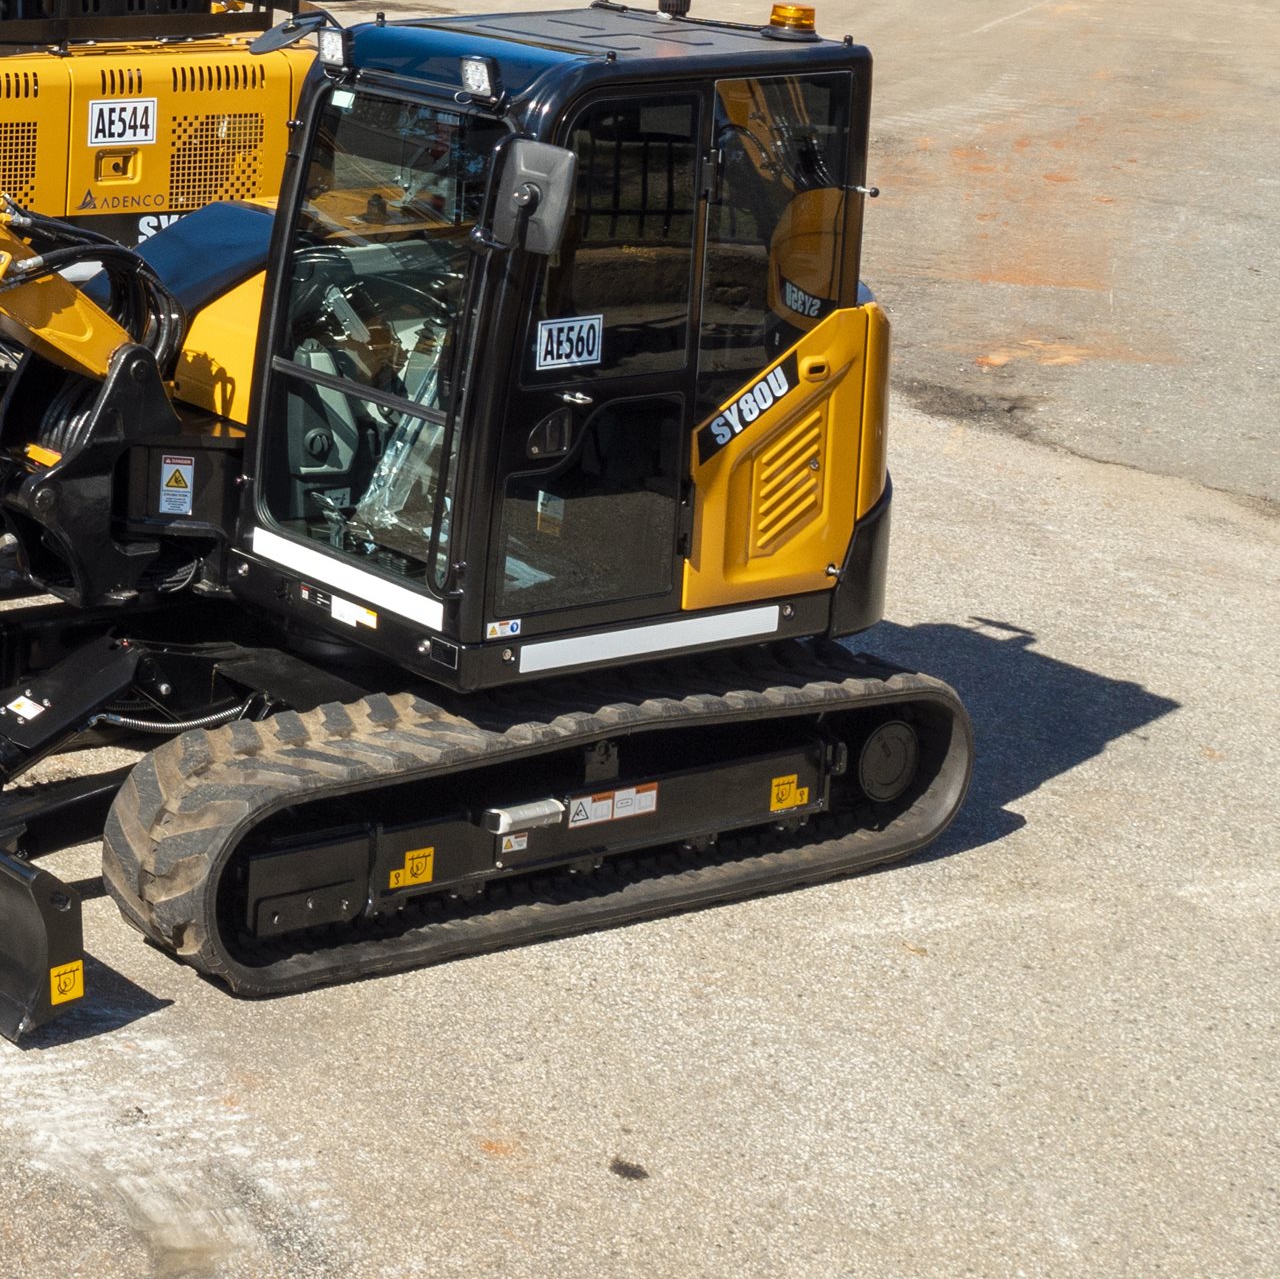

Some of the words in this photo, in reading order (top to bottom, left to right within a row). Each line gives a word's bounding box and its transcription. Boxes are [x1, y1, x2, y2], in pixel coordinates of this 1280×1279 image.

[94, 105, 150, 139] AE544
[100, 194, 165, 210] ADENCO
[138, 214, 188, 244] SY
[543, 323, 596, 362] AE560
[710, 366, 789, 445] SY80U
